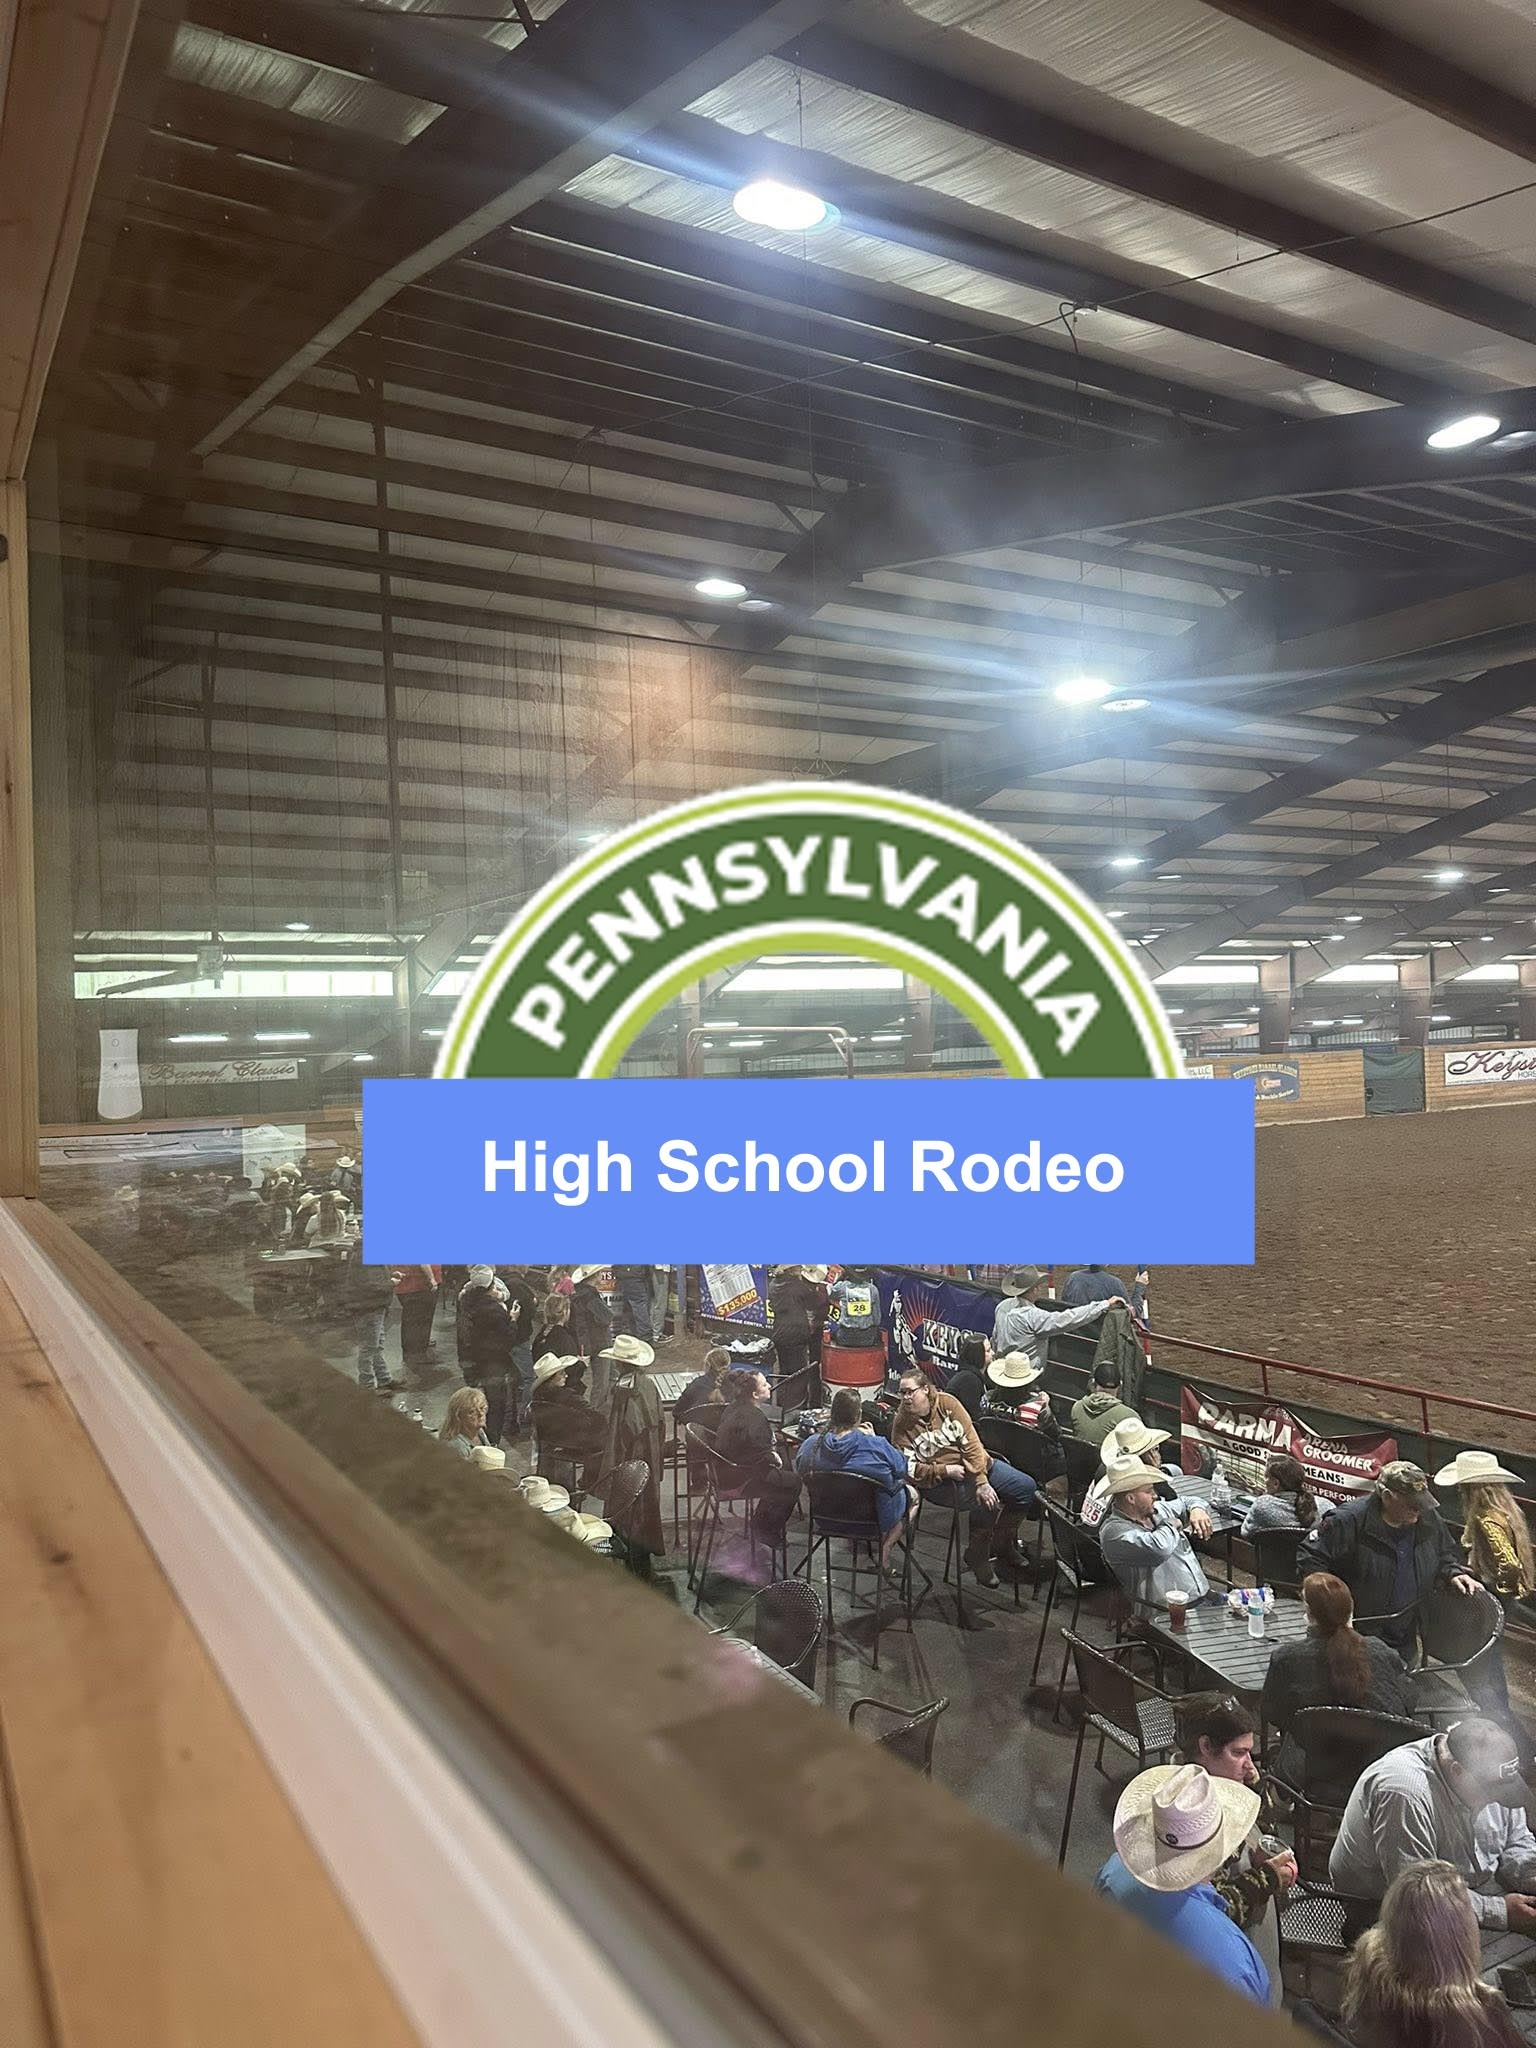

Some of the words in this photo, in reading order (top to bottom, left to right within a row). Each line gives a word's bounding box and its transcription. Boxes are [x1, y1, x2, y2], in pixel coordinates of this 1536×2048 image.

[717, 1288, 758, 1316] $135,000
[853, 1303, 866, 1312] 28
[1198, 1401, 1292, 1452] PARMA
[1223, 1439, 1230, 1449] A
[1232, 1442, 1262, 1457] GOOD
[1303, 1444, 1374, 1472] GROOMER
